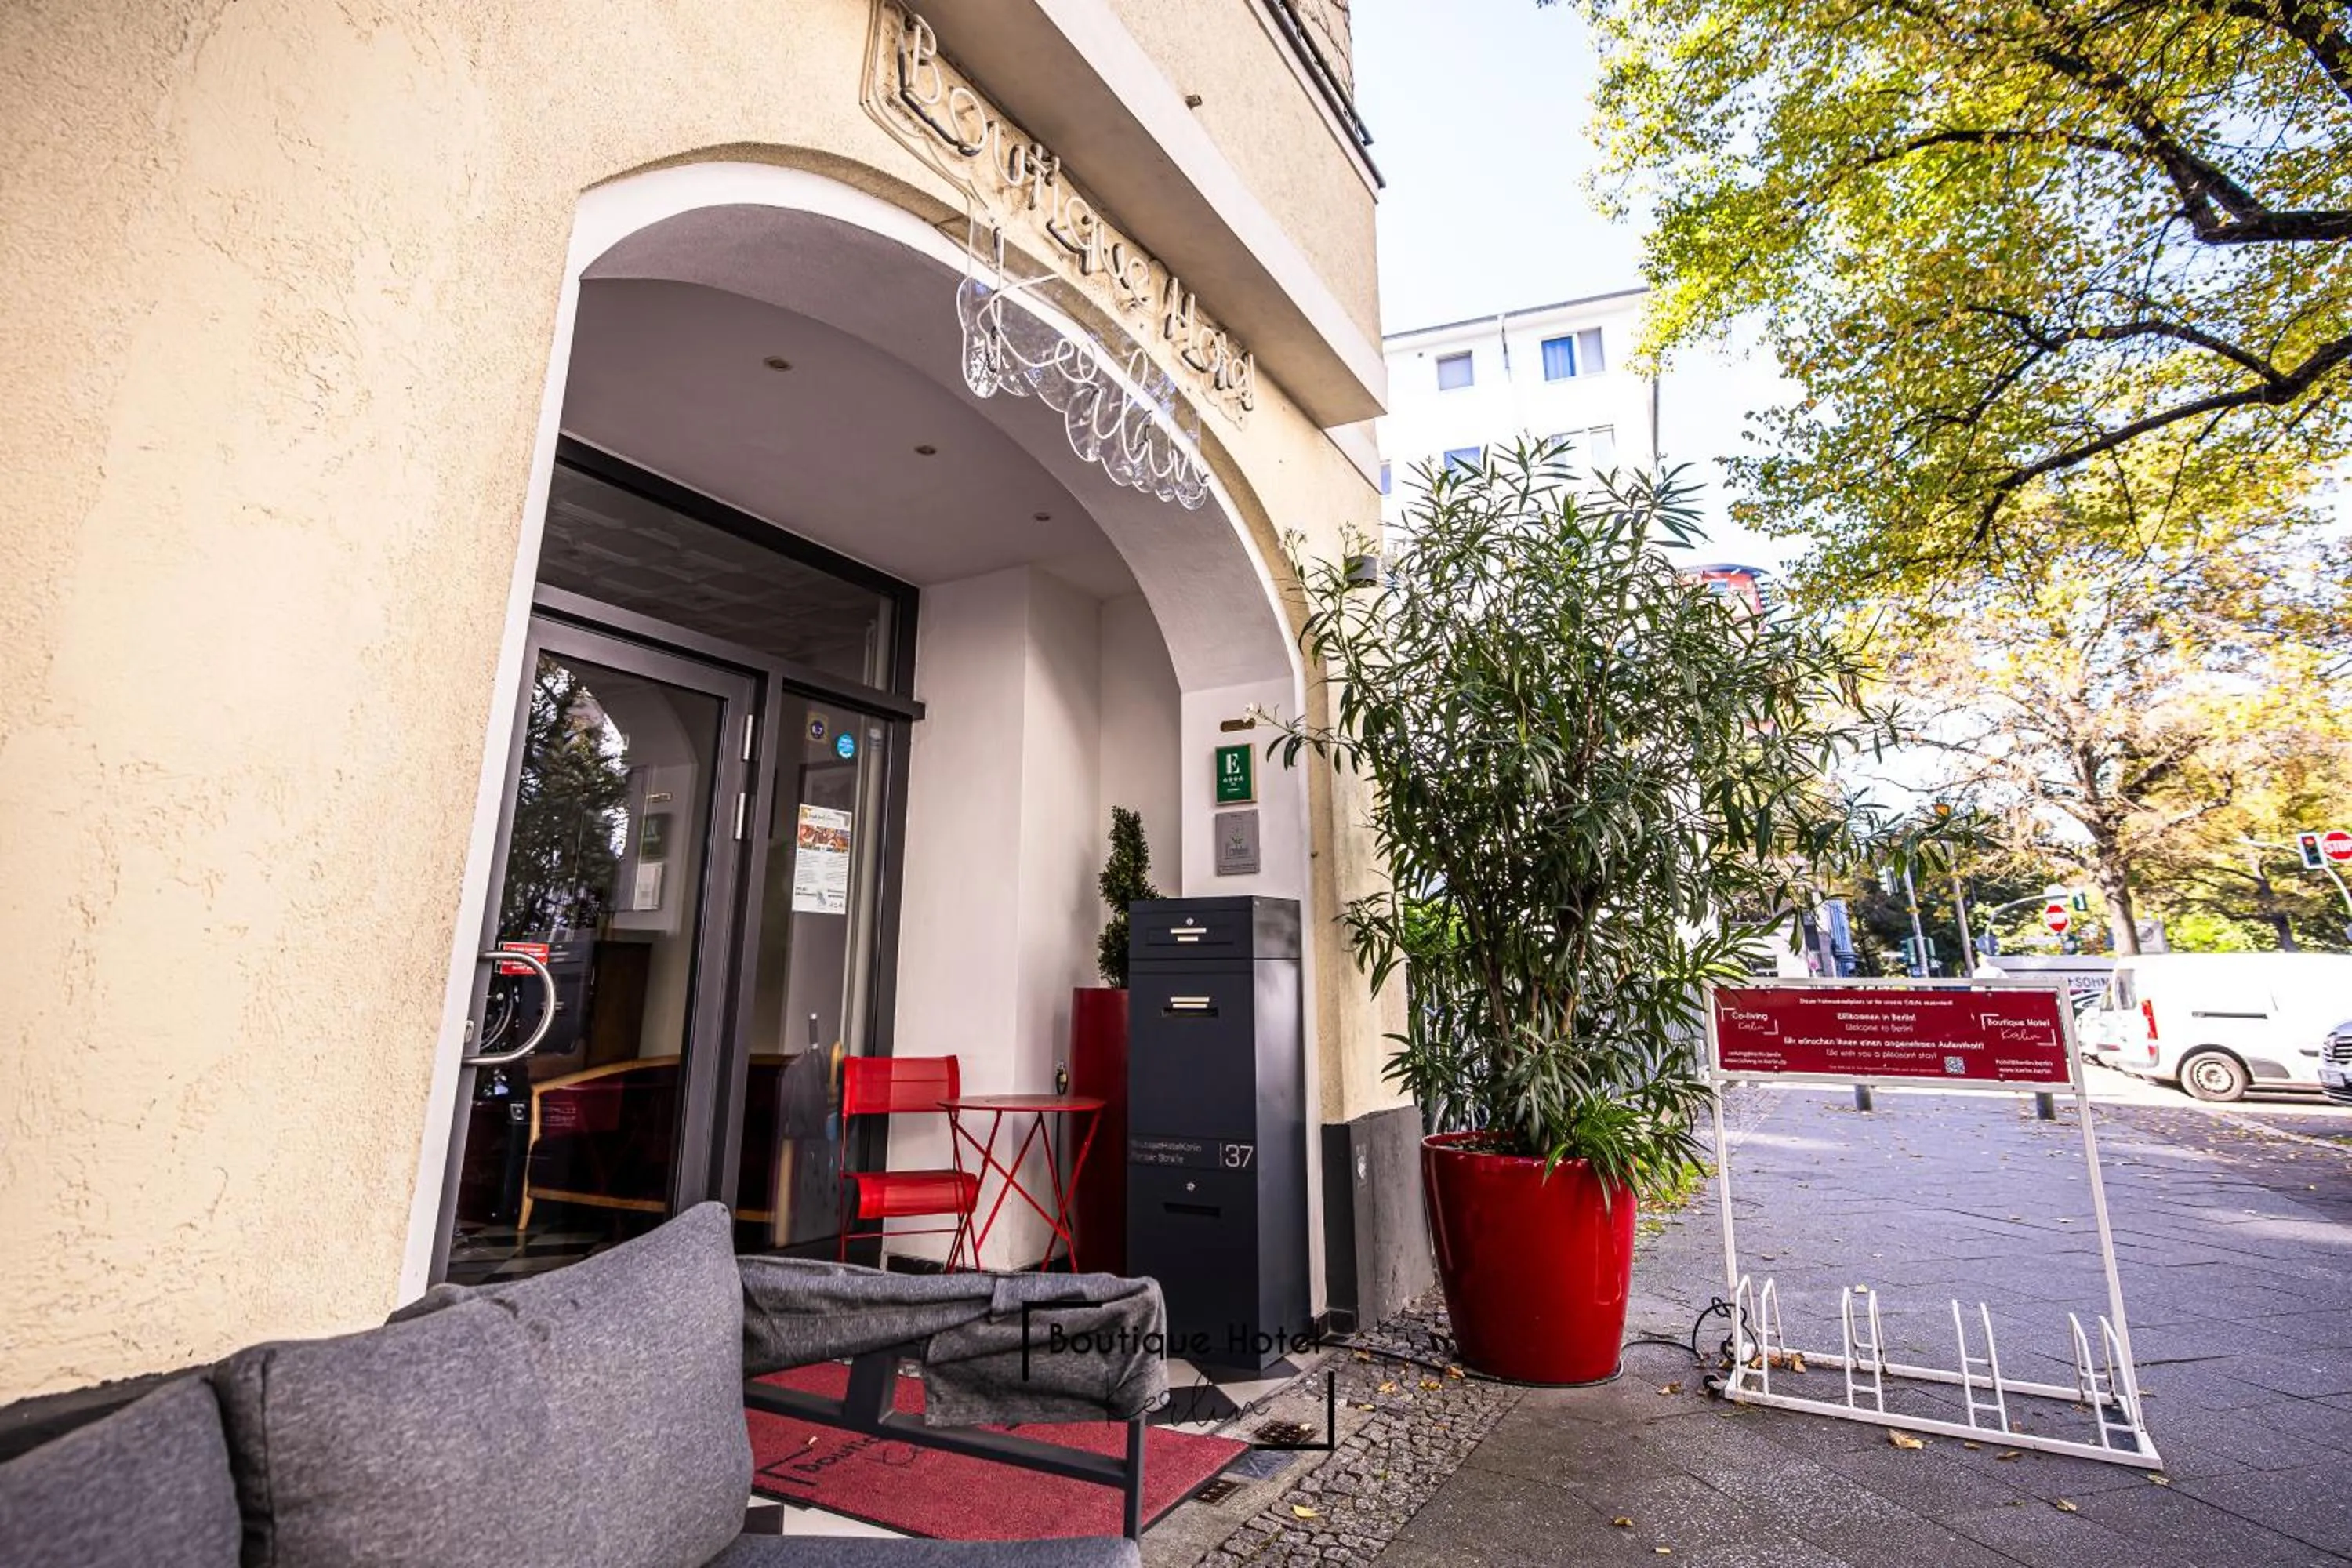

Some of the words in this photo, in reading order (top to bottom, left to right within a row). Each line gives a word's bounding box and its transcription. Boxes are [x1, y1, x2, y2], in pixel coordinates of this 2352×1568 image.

[898, 13, 1149, 303] Boutique
[1165, 276, 1255, 412] Hotel
[1226, 753, 1240, 774] E
[1987, 1018, 2025, 1027] Boutique
[1225, 1143, 1254, 1168] 37
